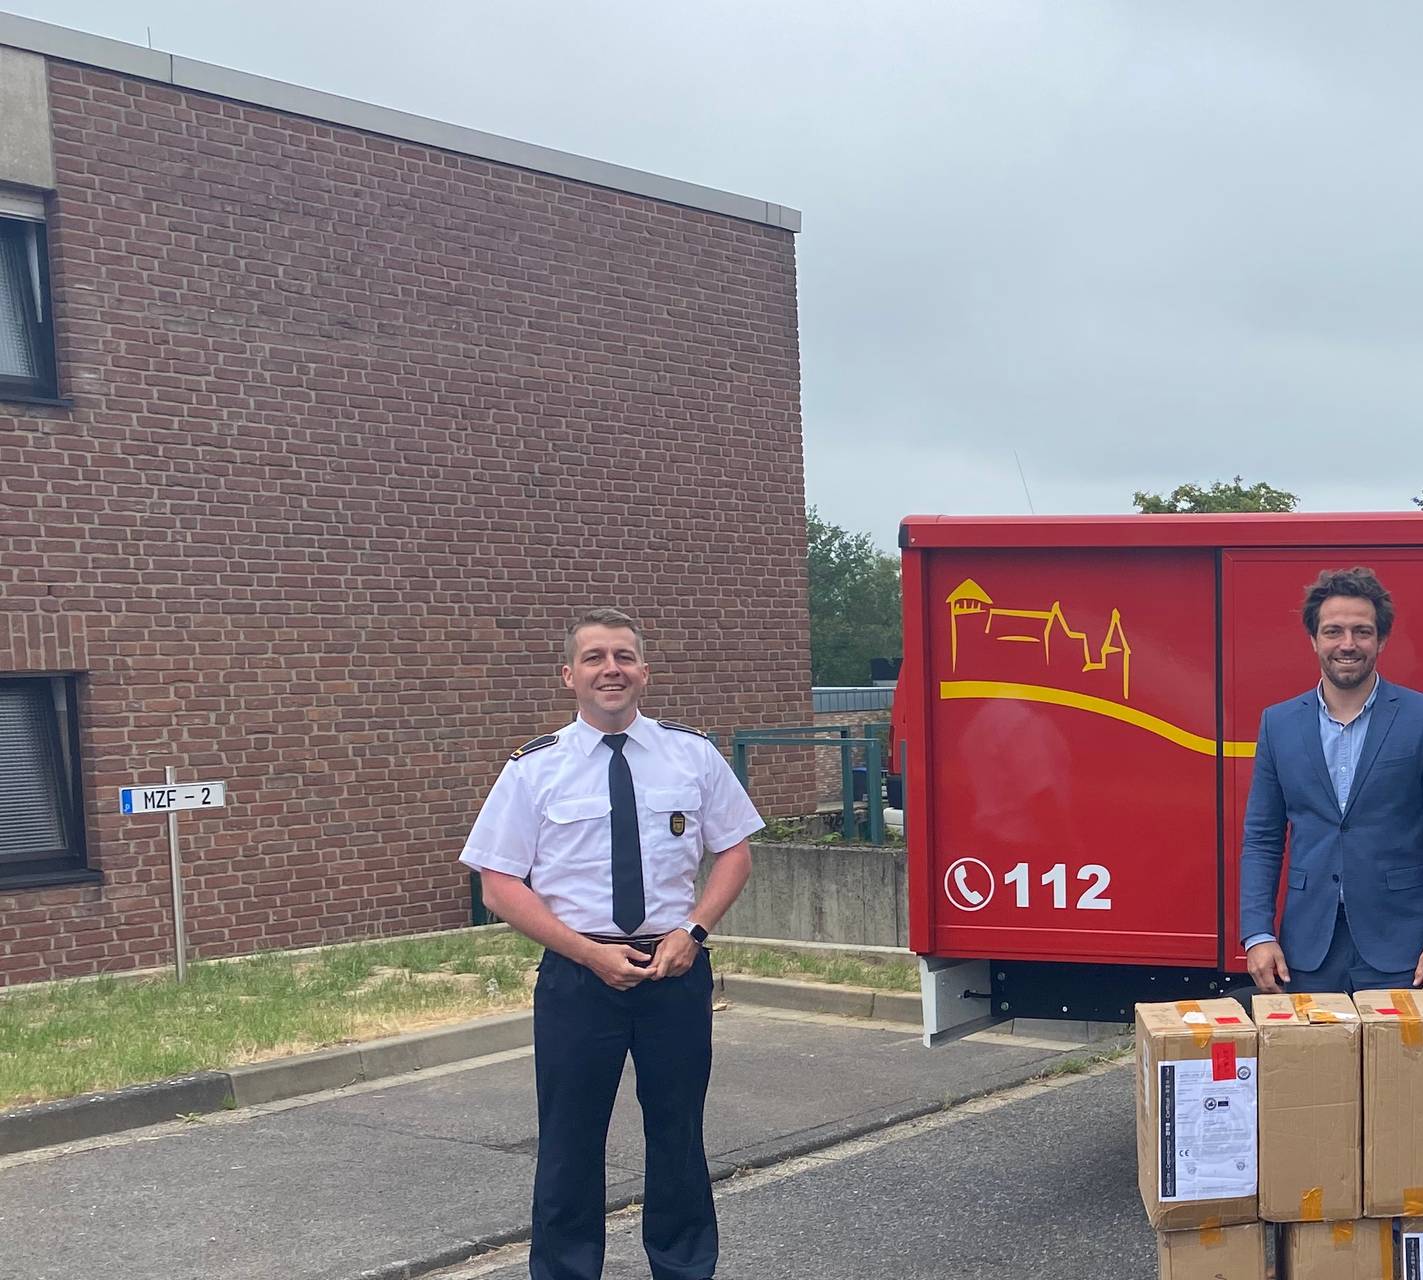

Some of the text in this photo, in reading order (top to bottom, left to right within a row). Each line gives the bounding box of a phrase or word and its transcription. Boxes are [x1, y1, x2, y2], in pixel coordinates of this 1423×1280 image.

[143, 789, 177, 809] MZF
[201, 787, 211, 805] 2
[1004, 862, 1112, 910] 112
